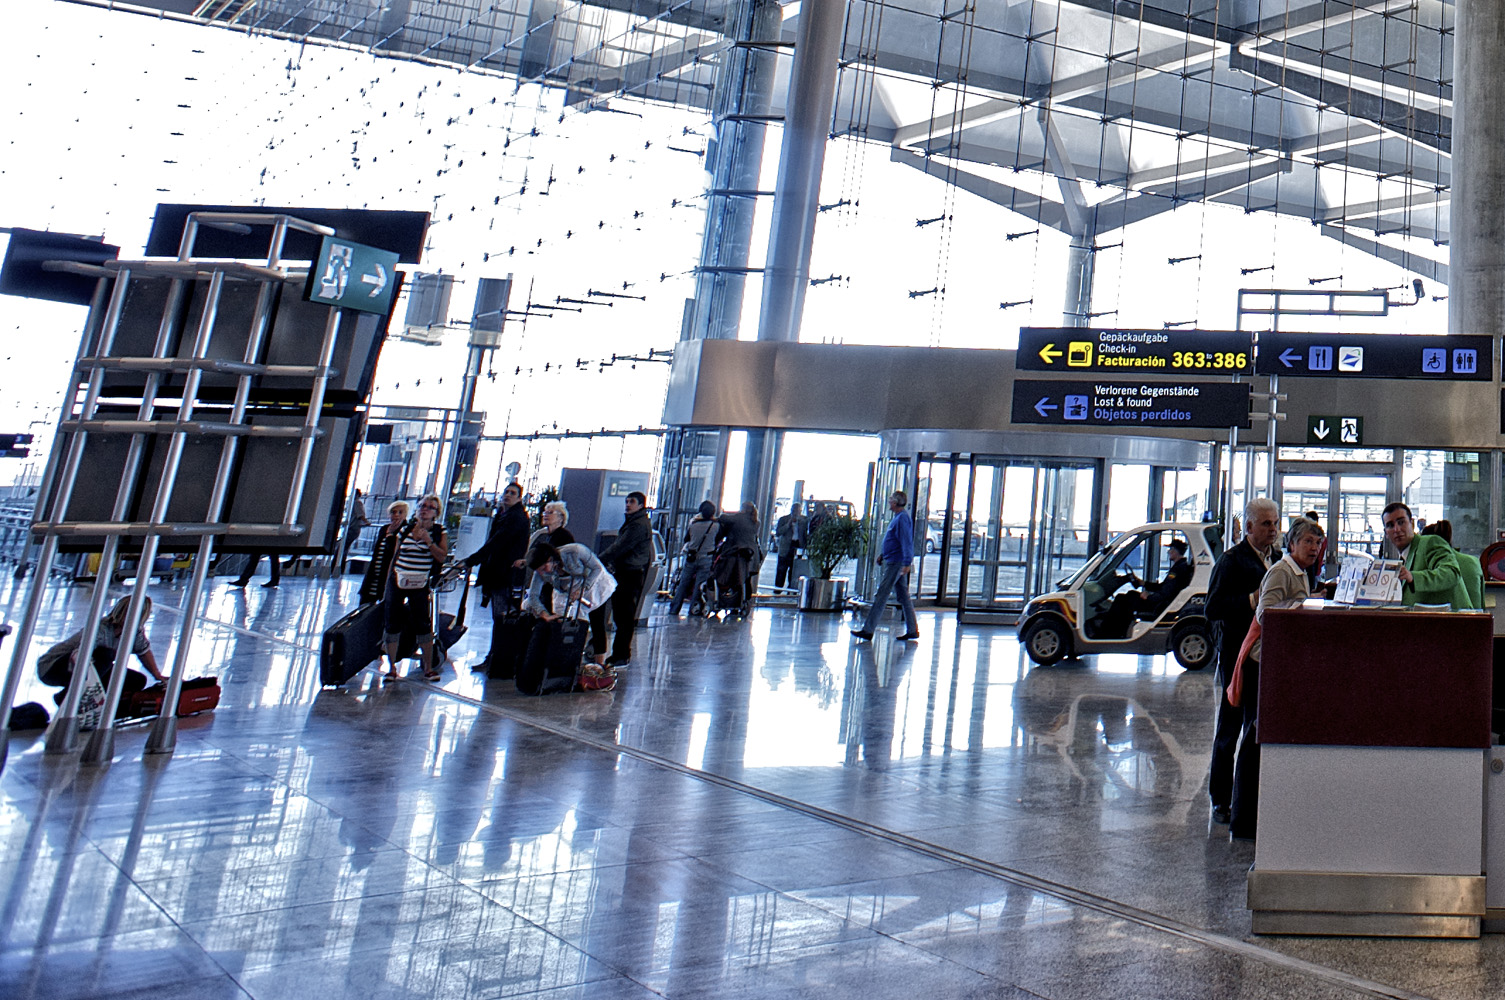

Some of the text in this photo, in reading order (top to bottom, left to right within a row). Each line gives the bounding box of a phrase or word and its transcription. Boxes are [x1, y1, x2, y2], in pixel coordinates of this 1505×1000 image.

[1099, 331, 1169, 344] Gepäckaufgabe
[1098, 343, 1137, 354] Check-in
[1097, 354, 1166, 368] Facturación
[1171, 351, 1206, 368] 363
[1213, 352, 1247, 369] 386
[1095, 384, 1200, 398] Verlorene Gegenstände
[1094, 396, 1153, 408] Lost & found
[1094, 408, 1192, 422] Objetos perdidos
